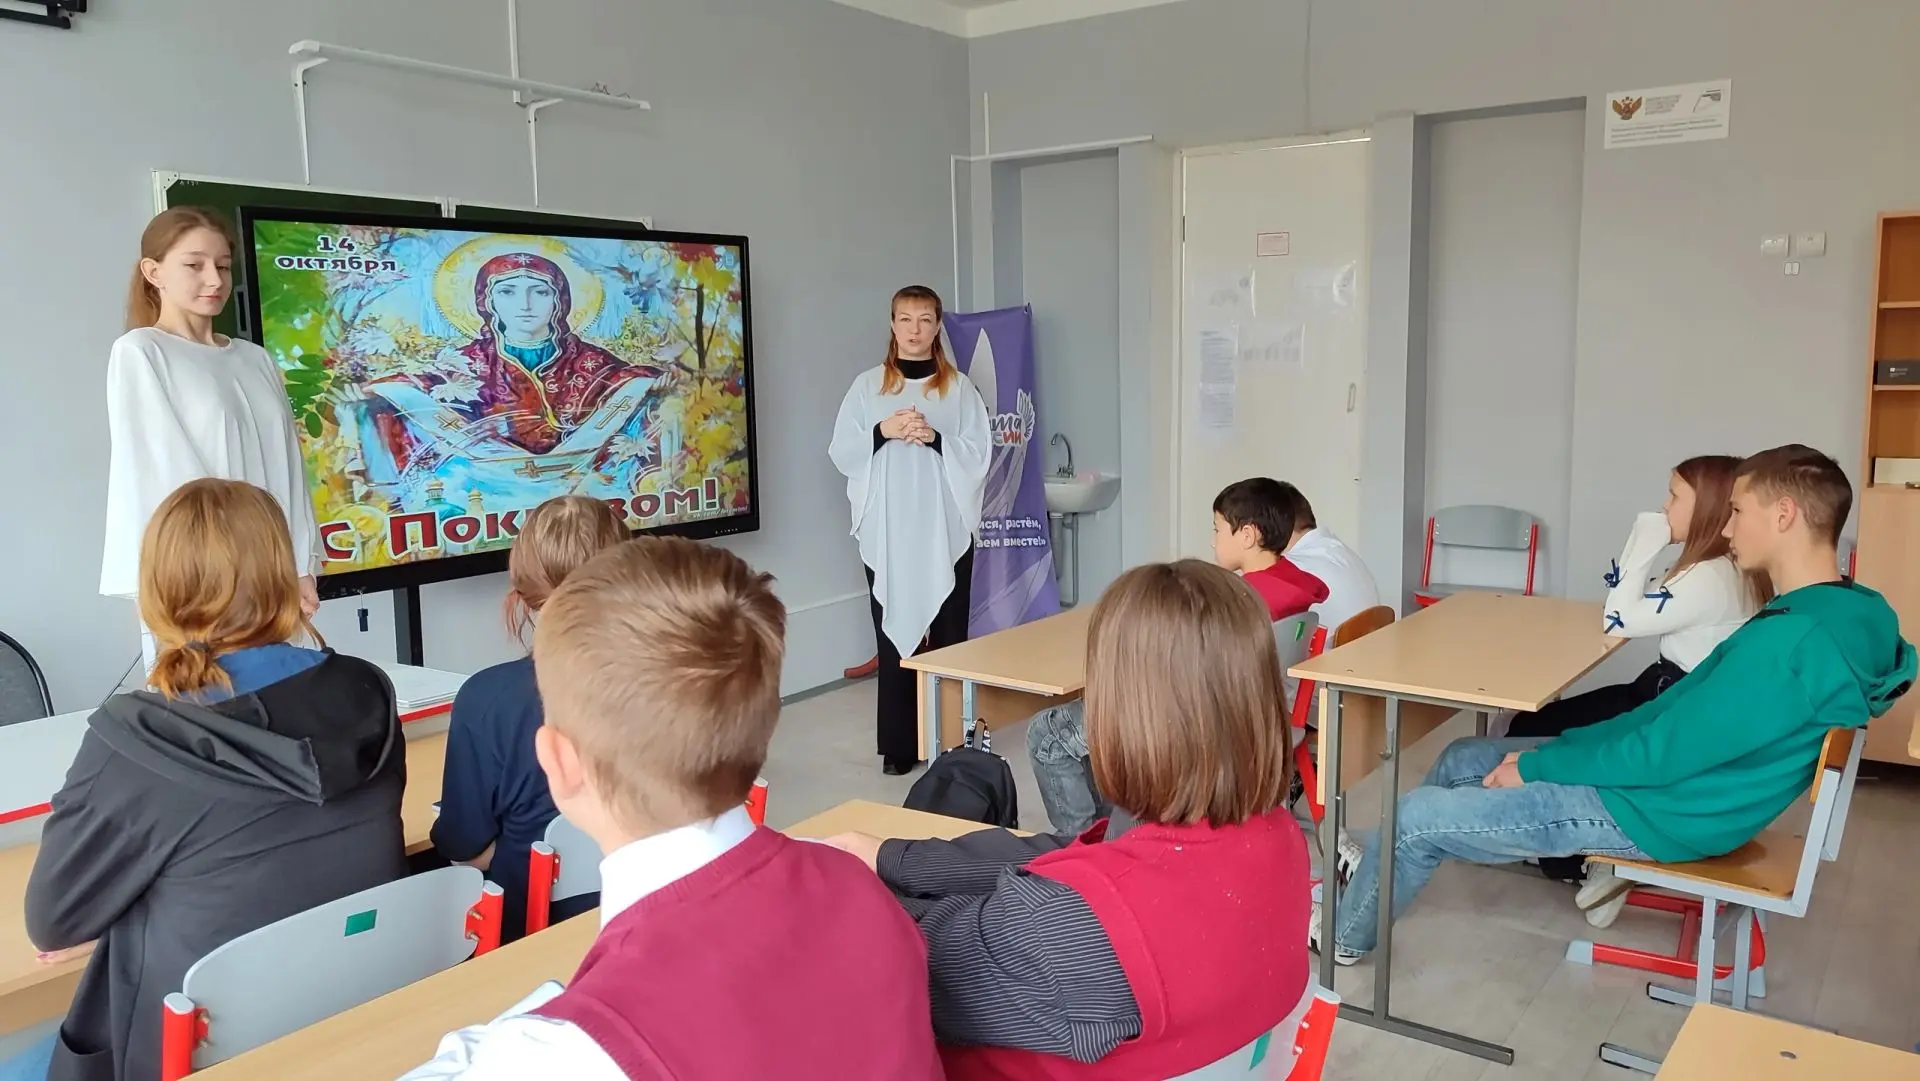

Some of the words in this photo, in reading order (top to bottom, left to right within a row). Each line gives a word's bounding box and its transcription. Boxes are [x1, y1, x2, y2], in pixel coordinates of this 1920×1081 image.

[317, 236, 356, 252] 14
[276, 256, 397, 274] октября
[387, 477, 719, 560] Поквом!
[975, 538, 1001, 549] аем
